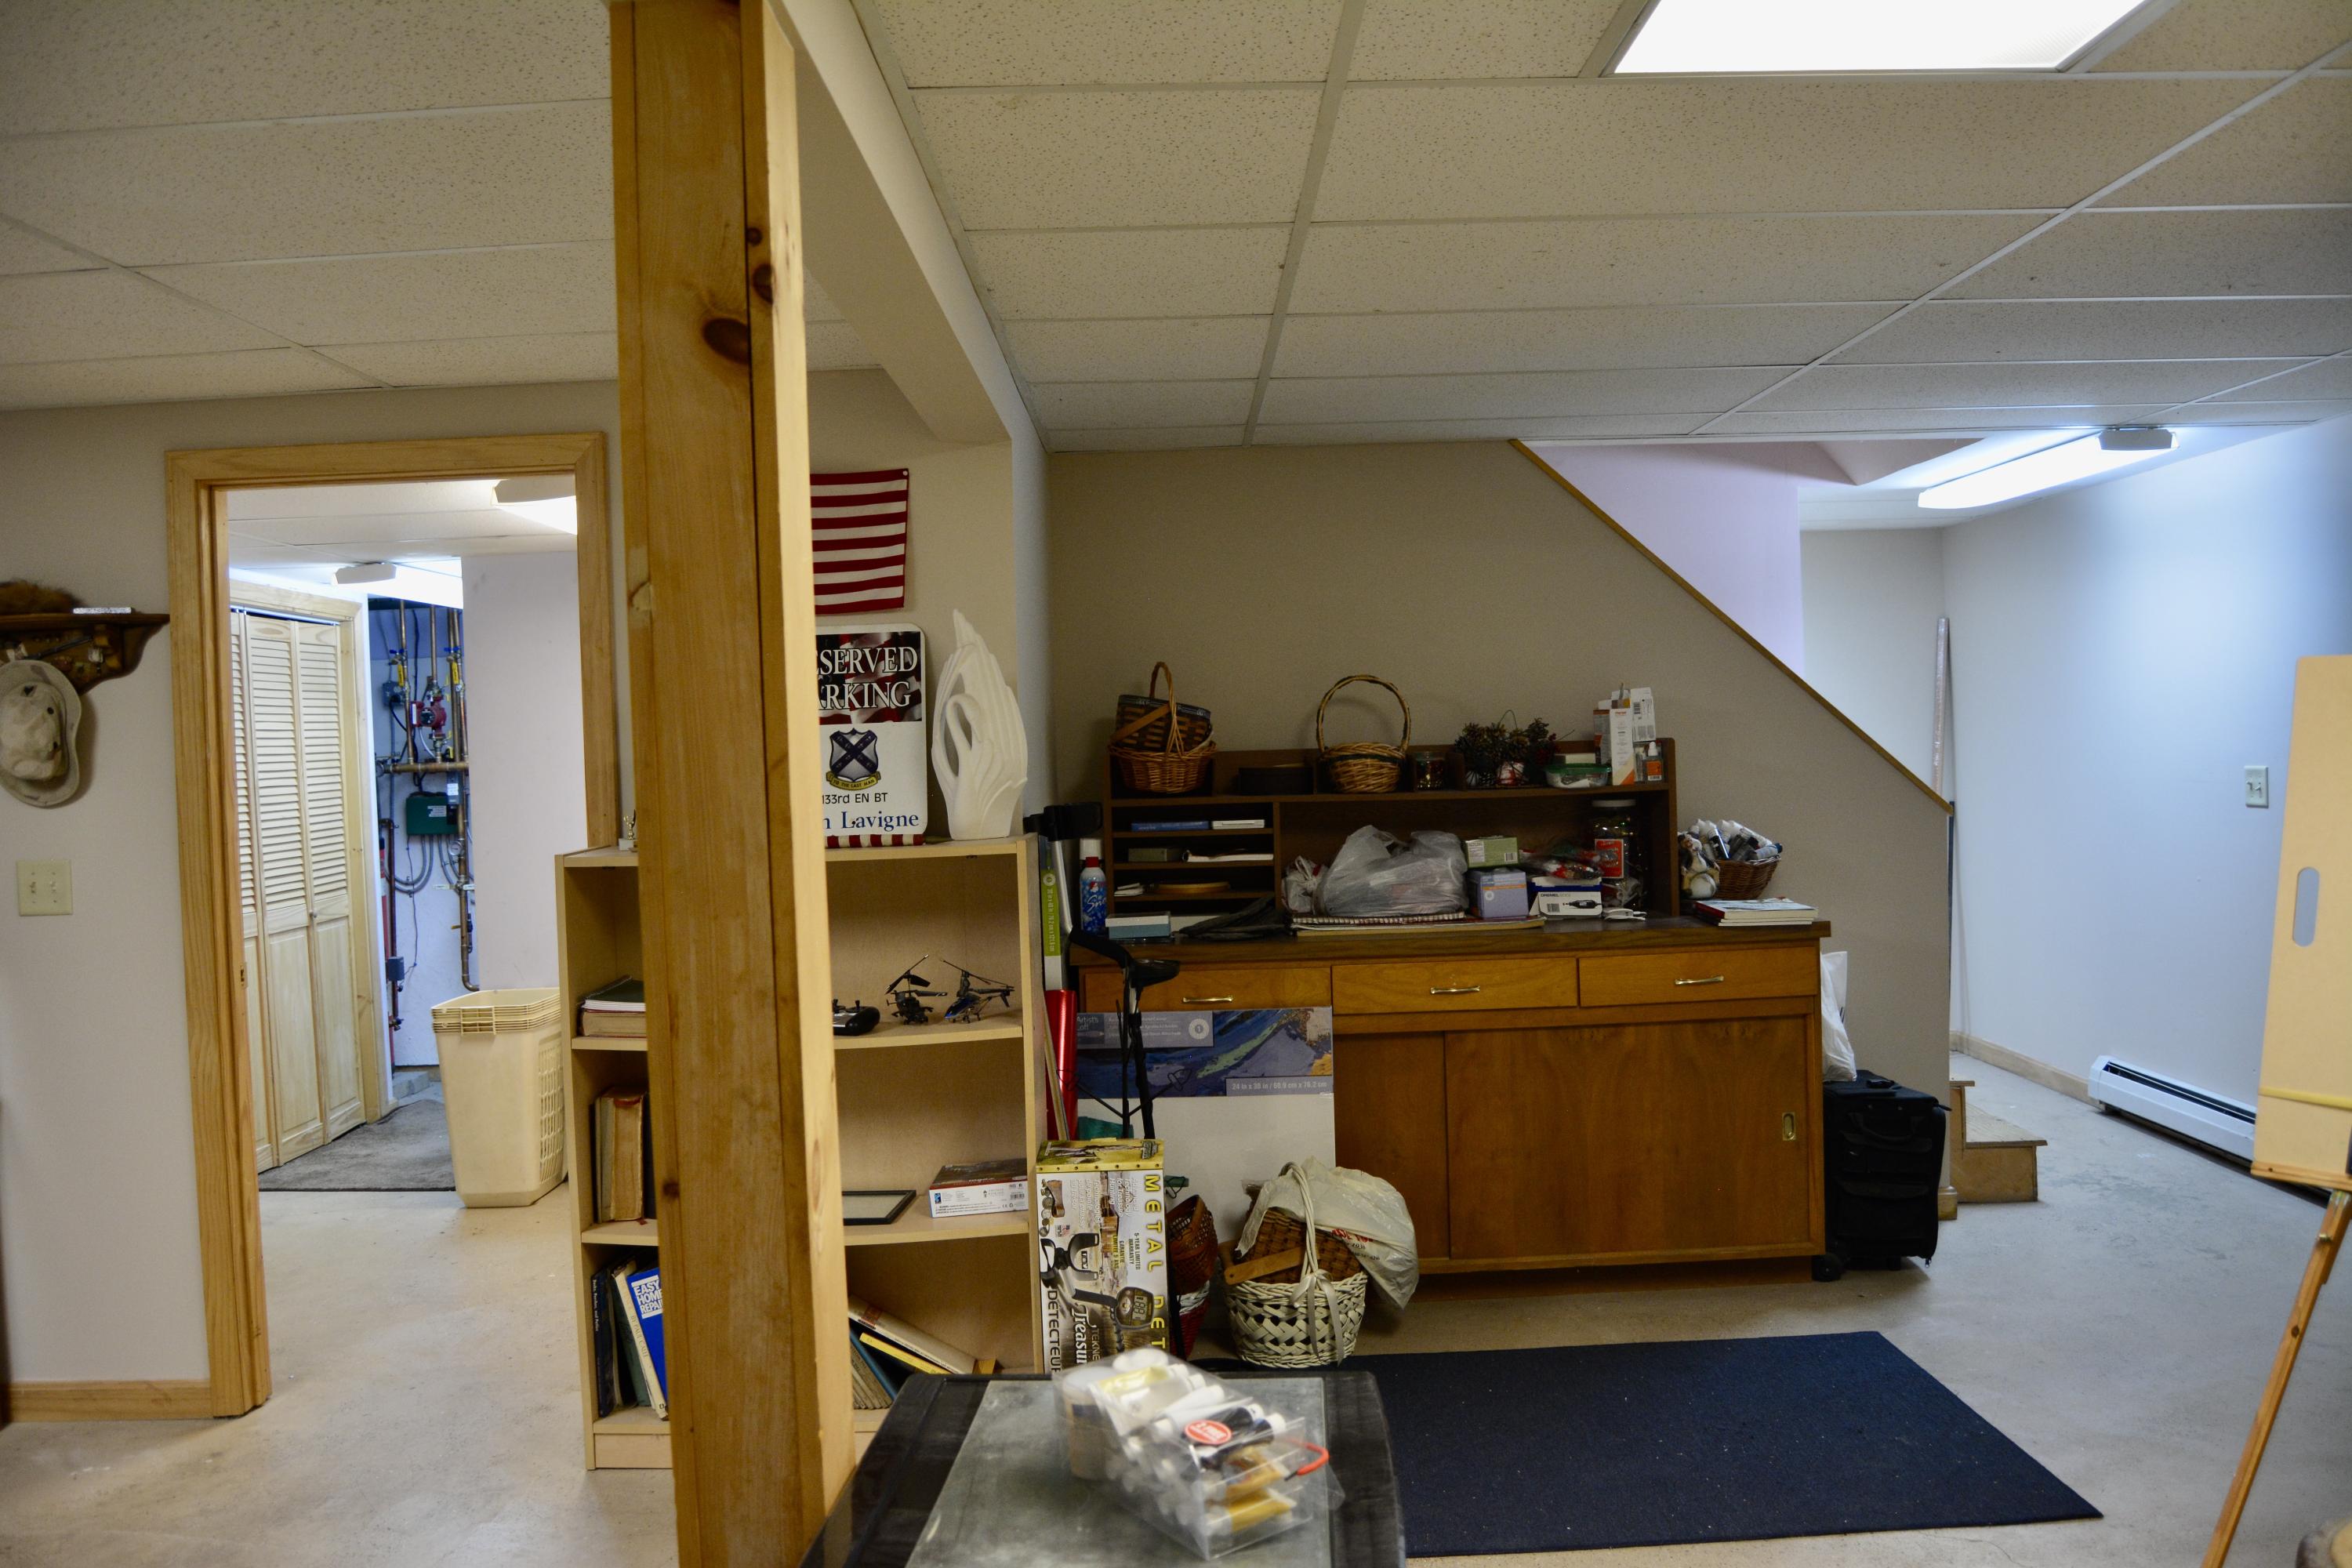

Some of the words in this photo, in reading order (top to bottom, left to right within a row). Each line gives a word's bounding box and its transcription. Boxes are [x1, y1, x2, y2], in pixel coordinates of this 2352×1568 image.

[816, 646, 918, 675] SERVED
[818, 681, 911, 710] RKING
[855, 793, 869, 804] EN
[874, 793, 887, 803] BT
[841, 810, 920, 832] Lavigne
[1145, 1174, 1163, 1272] METAL
[633, 1279, 659, 1296] EASY
[1150, 1295, 1166, 1349] DET
[1091, 1328, 1101, 1361] TEKNE
